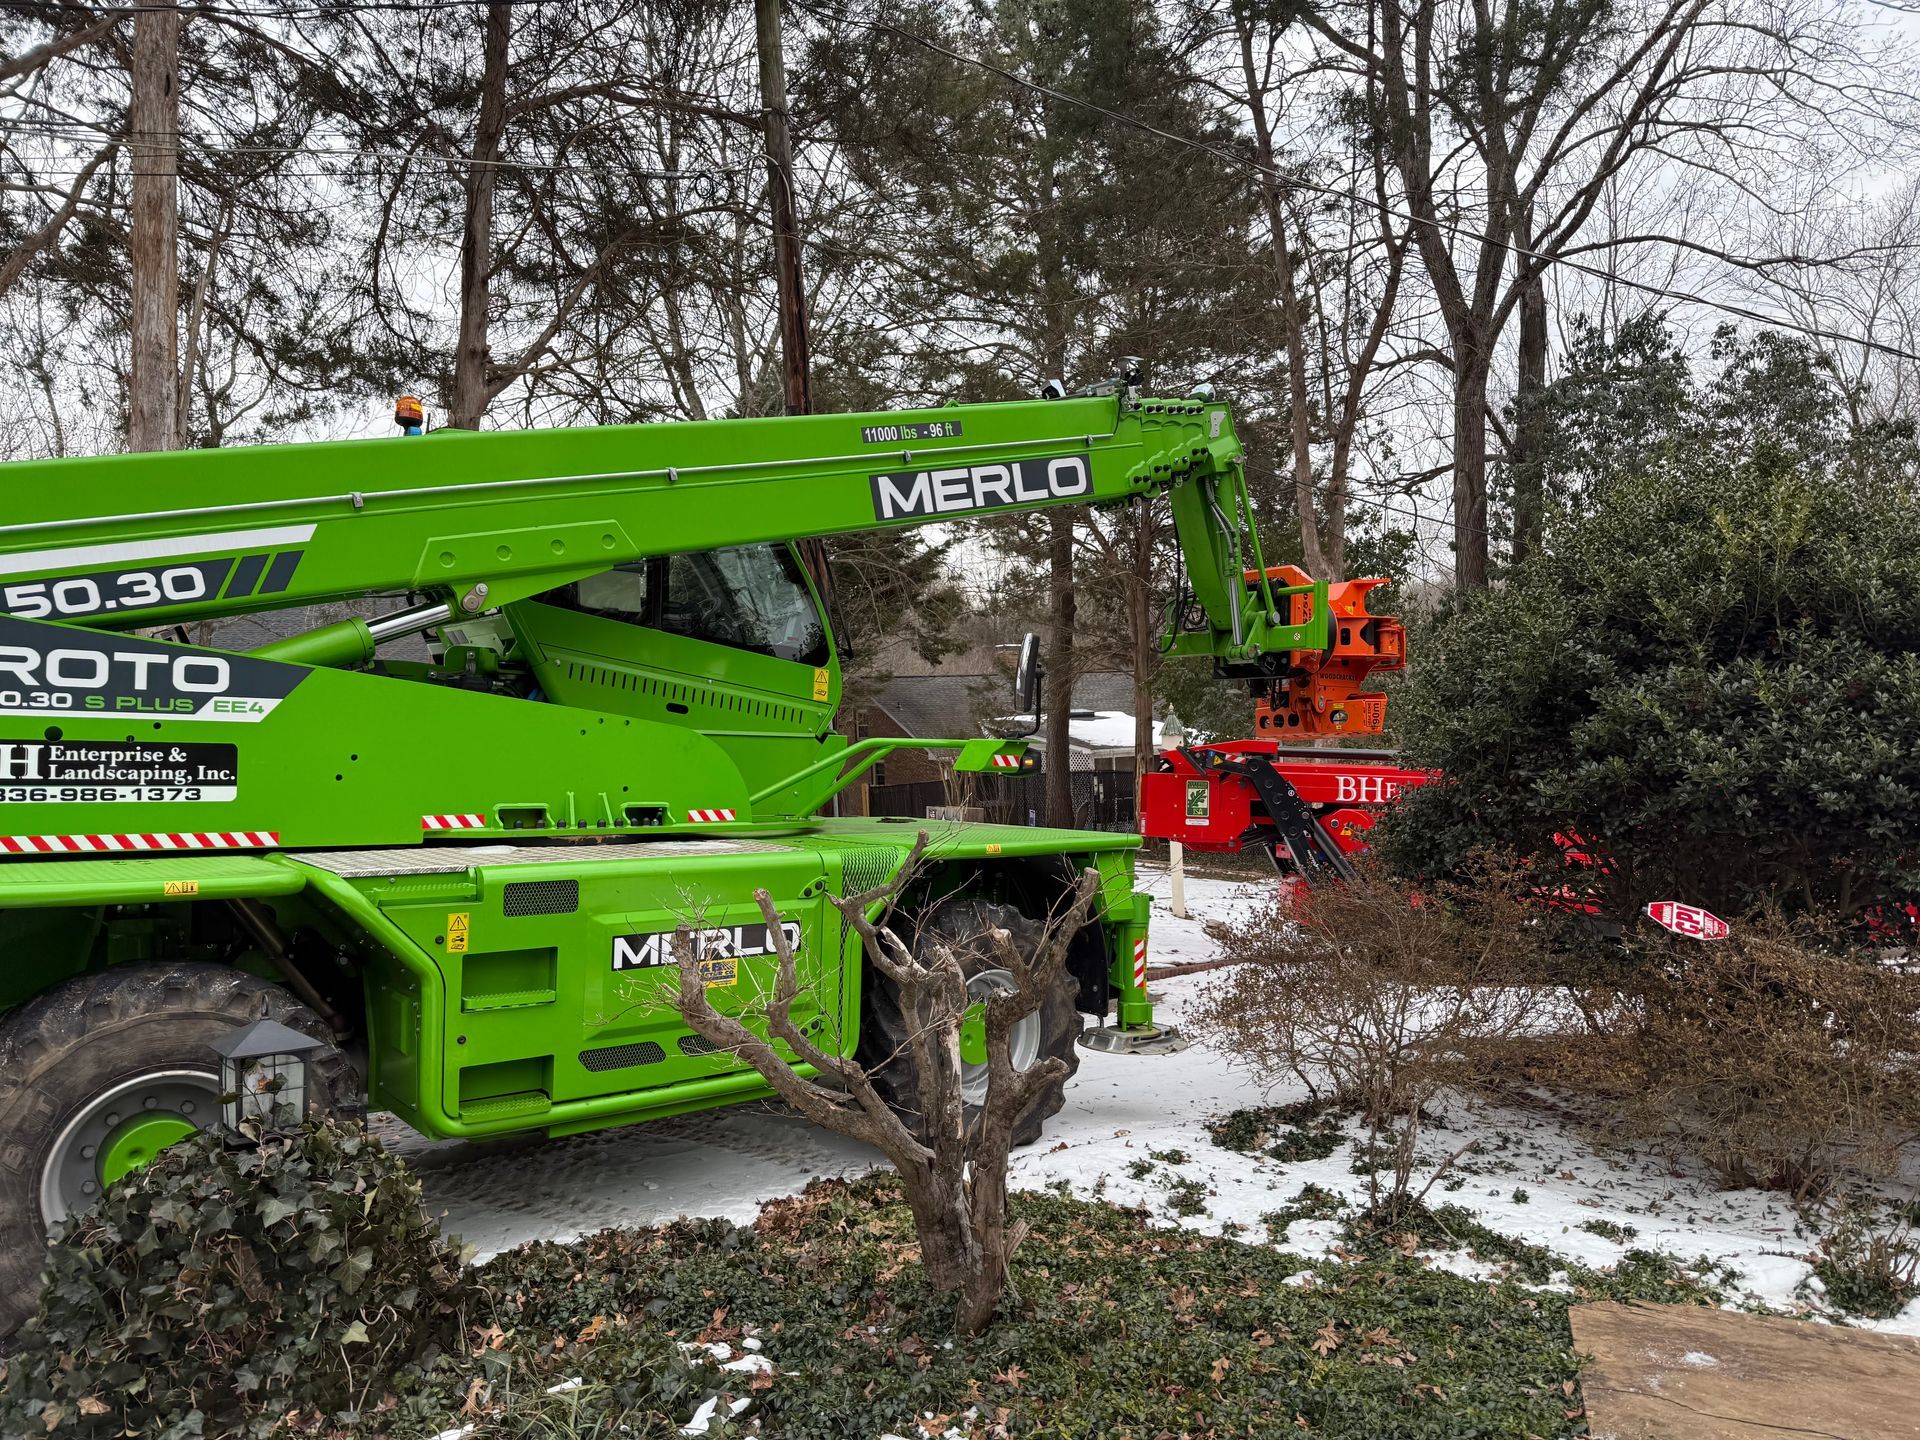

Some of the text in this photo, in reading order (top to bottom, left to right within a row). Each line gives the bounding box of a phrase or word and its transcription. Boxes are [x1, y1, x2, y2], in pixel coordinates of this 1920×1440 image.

[865, 426, 898, 442] 11000
[900, 425, 918, 440] lbs
[929, 423, 943, 438] 96
[945, 422, 954, 437] ft
[877, 456, 1088, 519] MERLO
[4, 566, 206, 619] 50.30
[0, 645, 231, 693] ROTO
[84, 695, 106, 709] S
[116, 695, 195, 712] PLUS
[213, 699, 265, 714] EE4
[1372, 703, 1380, 725] 90m
[48, 744, 188, 767] Enterprise &
[48, 764, 236, 785] Landscaping, Inc.
[1675, 904, 1701, 935] CPI
